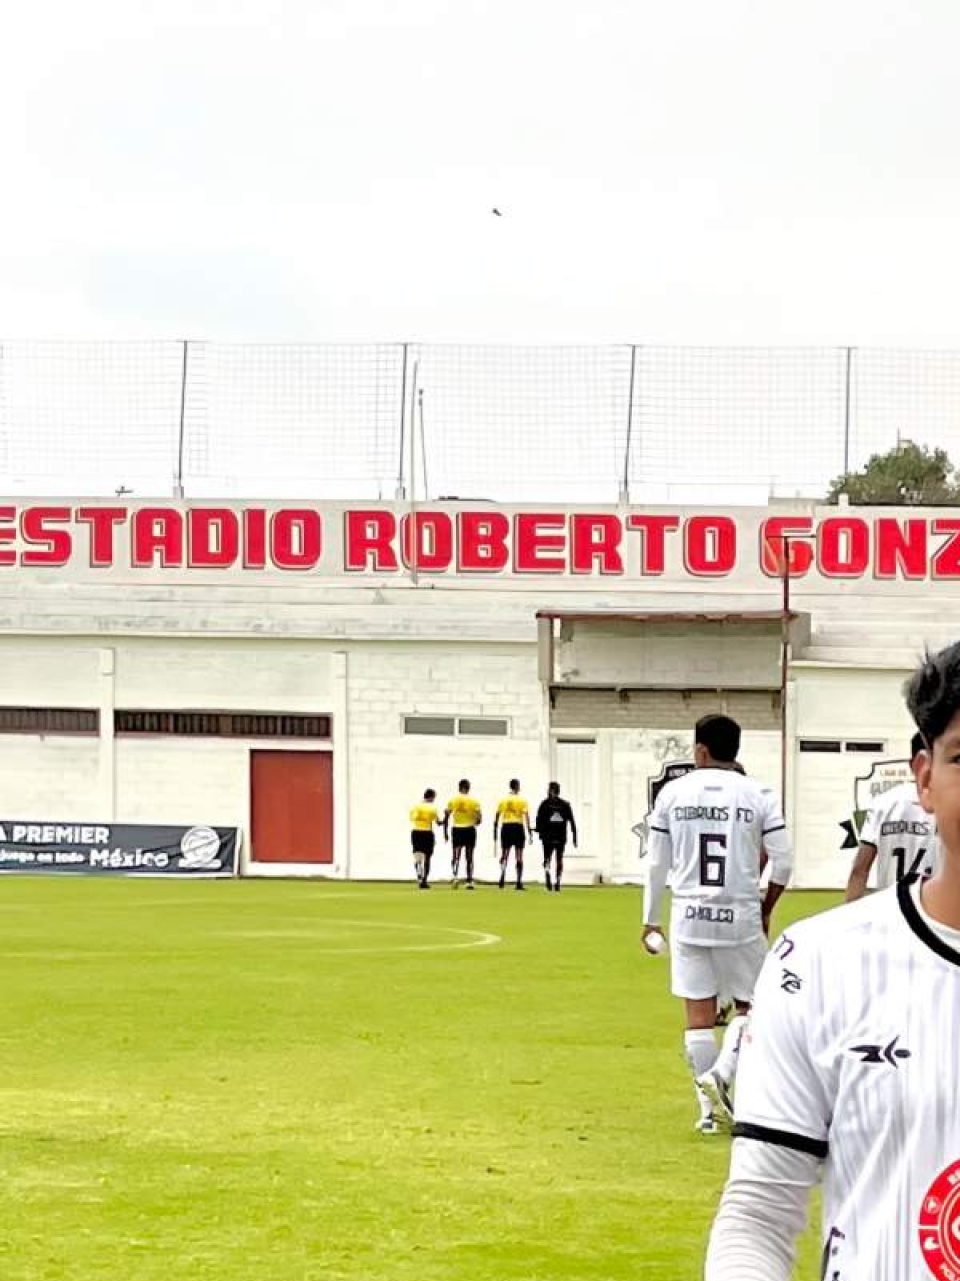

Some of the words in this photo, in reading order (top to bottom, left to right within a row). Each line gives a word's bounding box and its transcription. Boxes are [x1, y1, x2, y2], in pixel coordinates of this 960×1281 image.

[344, 510, 737, 577] ROBERTO
[12, 825, 110, 844] PREMIER
[88, 848, 169, 867] México
[699, 833, 728, 888] 6
